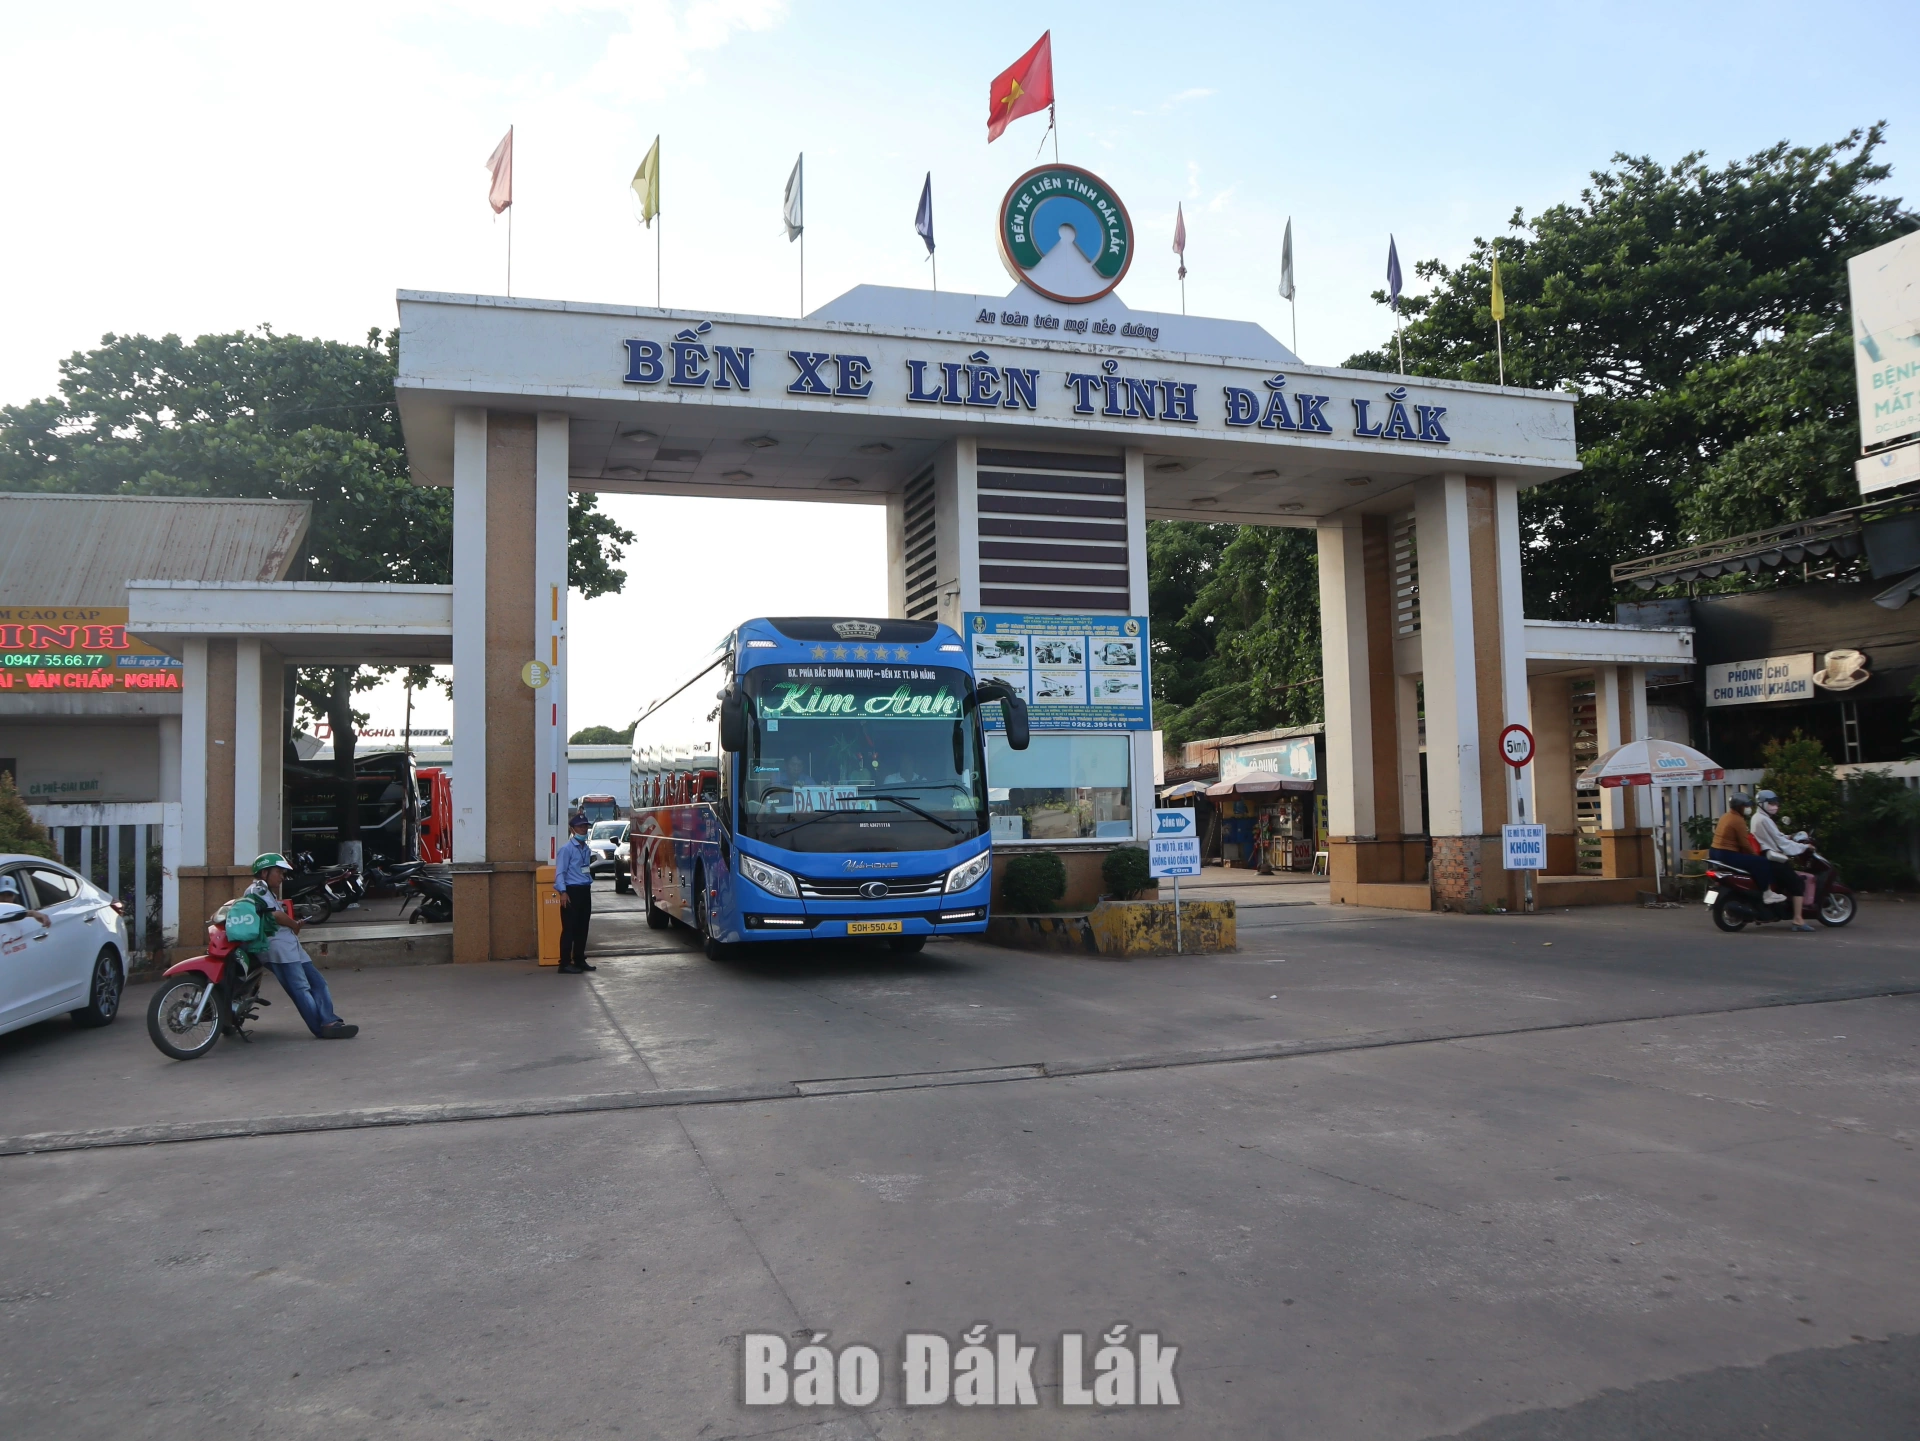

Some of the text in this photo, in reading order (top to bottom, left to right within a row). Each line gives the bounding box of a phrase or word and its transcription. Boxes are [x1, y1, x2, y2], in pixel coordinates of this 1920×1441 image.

[1011, 177, 1125, 255] BẾN XE LIÊN TỈNH ĐẮK LẮK
[976, 308, 1160, 342] An toàn trên mọi nẻo đường
[623, 320, 1451, 444] BẾN XE LIÊN TỈNH ĐẮK LẮK
[1874, 387, 1914, 419] MẮT
[18, 611, 57, 620] CAO
[63, 608, 100, 620] CẤP
[162, 656, 171, 665] 1
[25, 669, 61, 688] VĂN
[63, 667, 114, 688] CHẤN
[125, 668, 178, 688] NGHĨA
[531, 663, 541, 685] STOP
[1728, 662, 1790, 683] PHÒNG CHỜ
[764, 682, 960, 714] Kim Anh
[1713, 679, 1806, 700] CHO HÀNH KHÁCH
[1657, 758, 1687, 768] OMO
[1510, 839, 1540, 854] KHÔNG
[257, 858, 270, 867] Grab
[226, 913, 255, 928] Grab
[851, 922, 898, 932] 50H-550.43
